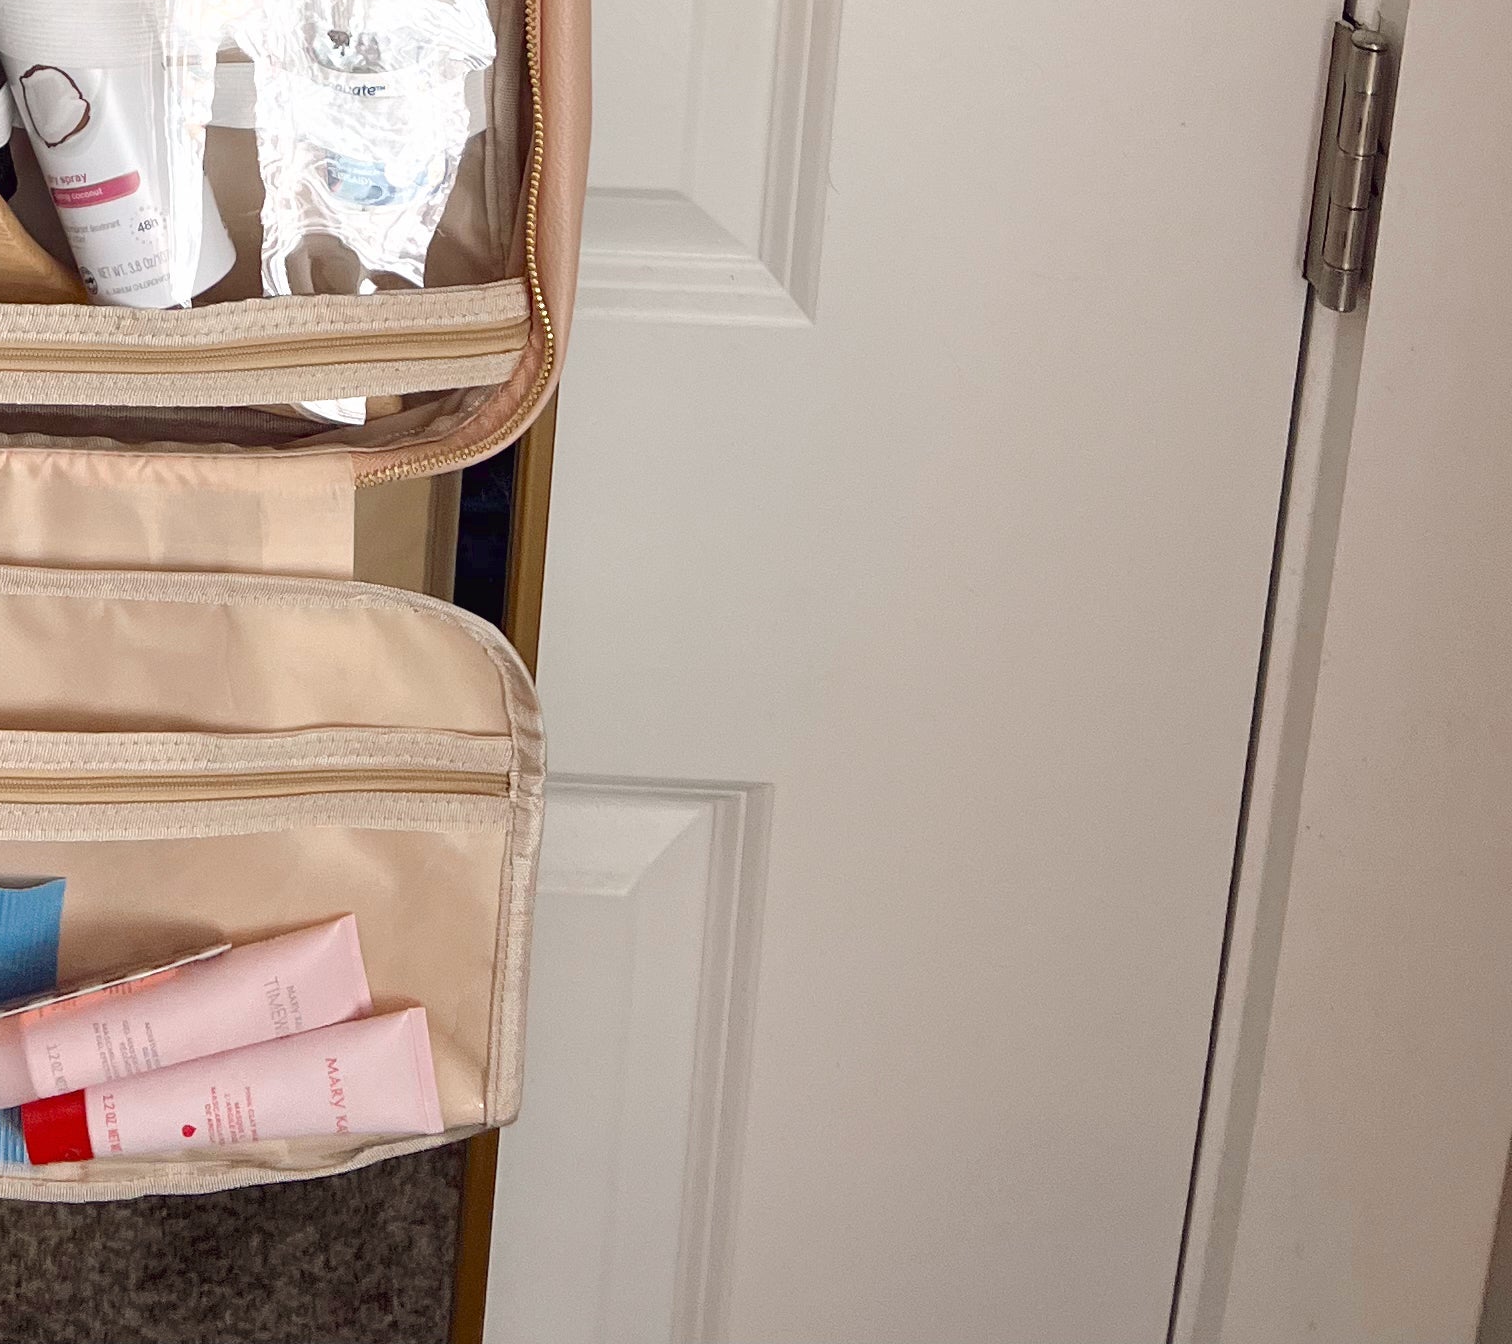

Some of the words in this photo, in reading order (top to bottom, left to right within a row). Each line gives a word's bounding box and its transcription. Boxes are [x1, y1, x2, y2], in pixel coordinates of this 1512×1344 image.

[60, 173, 87, 185] spray
[71, 187, 103, 200] coconut
[137, 217, 159, 234] 48h
[129, 260, 142, 275] 3.8
[263, 975, 289, 1031] TIMEW
[325, 1057, 346, 1109] MARY
[102, 1093, 116, 1111] 1.2
[105, 1112, 118, 1128] OZ
[335, 1114, 349, 1134] KA
